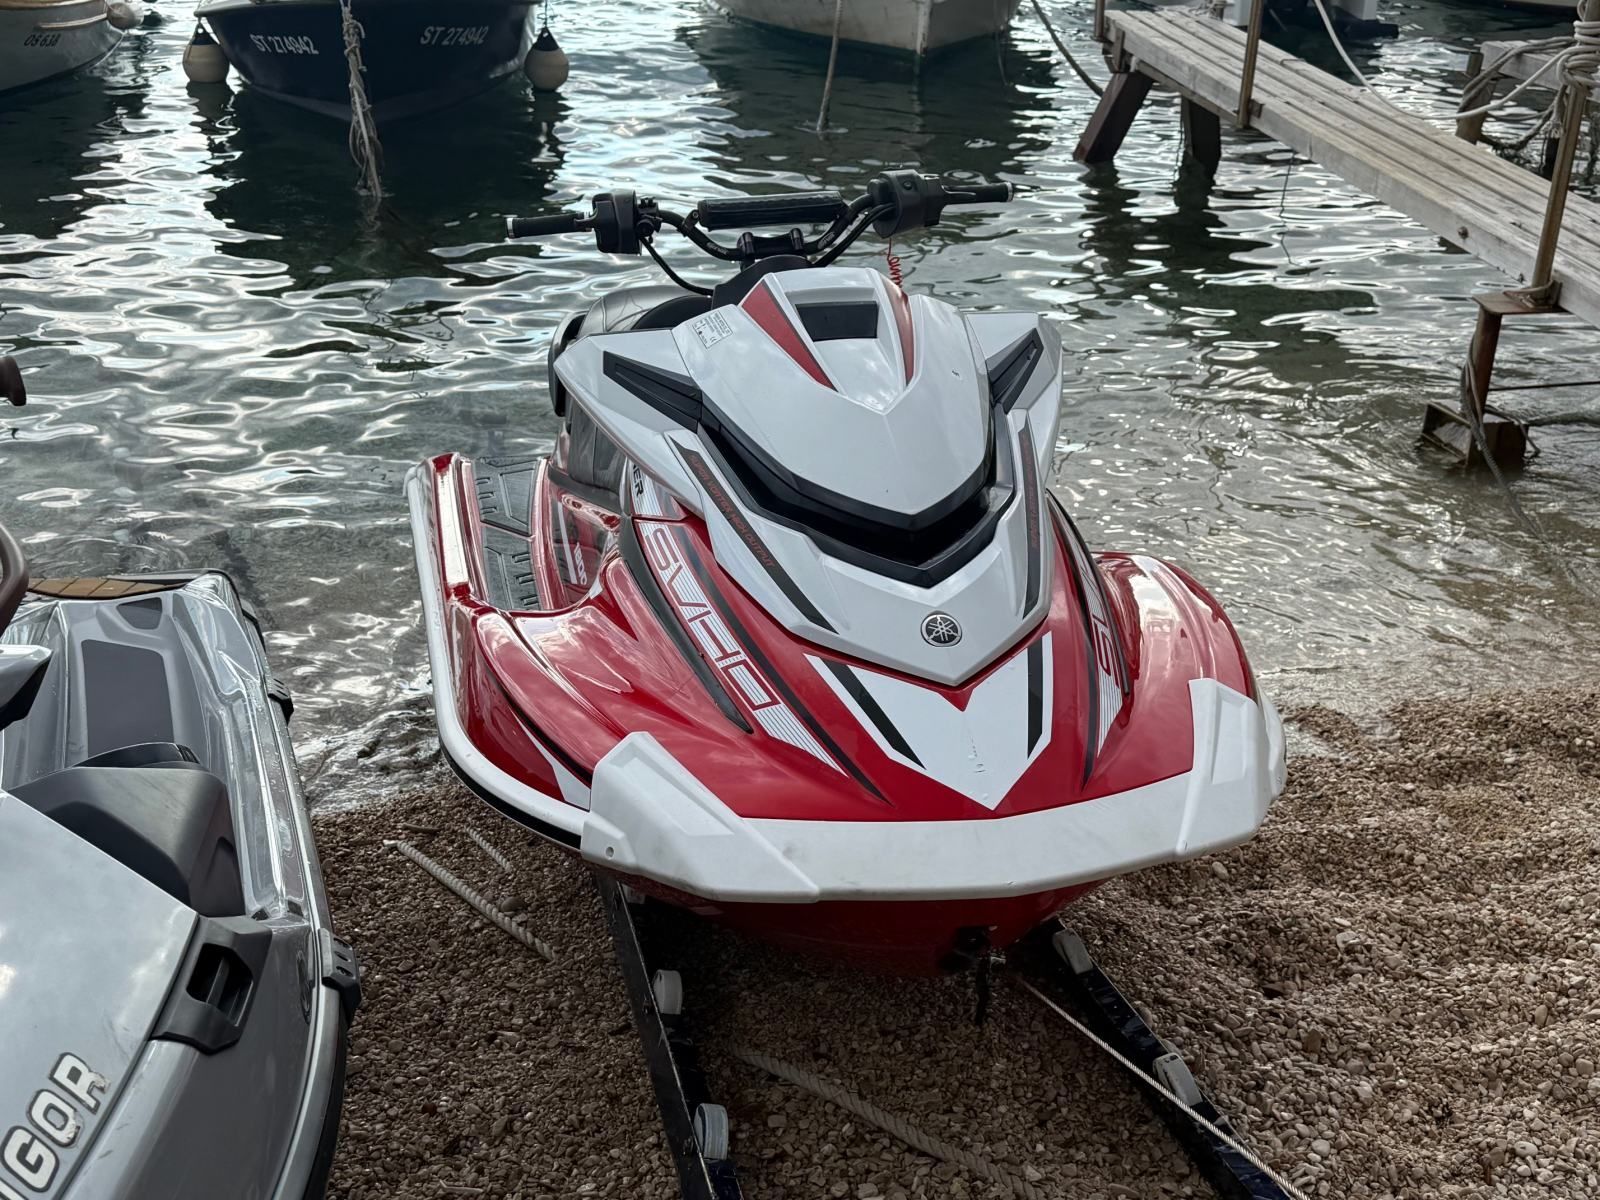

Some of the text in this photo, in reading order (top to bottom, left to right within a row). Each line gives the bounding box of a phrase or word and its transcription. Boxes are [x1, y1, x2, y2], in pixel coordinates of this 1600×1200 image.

[250, 34, 319, 55] ST 274942
[420, 26, 489, 45] ST 274942
[633, 463, 644, 497] ER
[646, 527, 782, 712] SVHO
